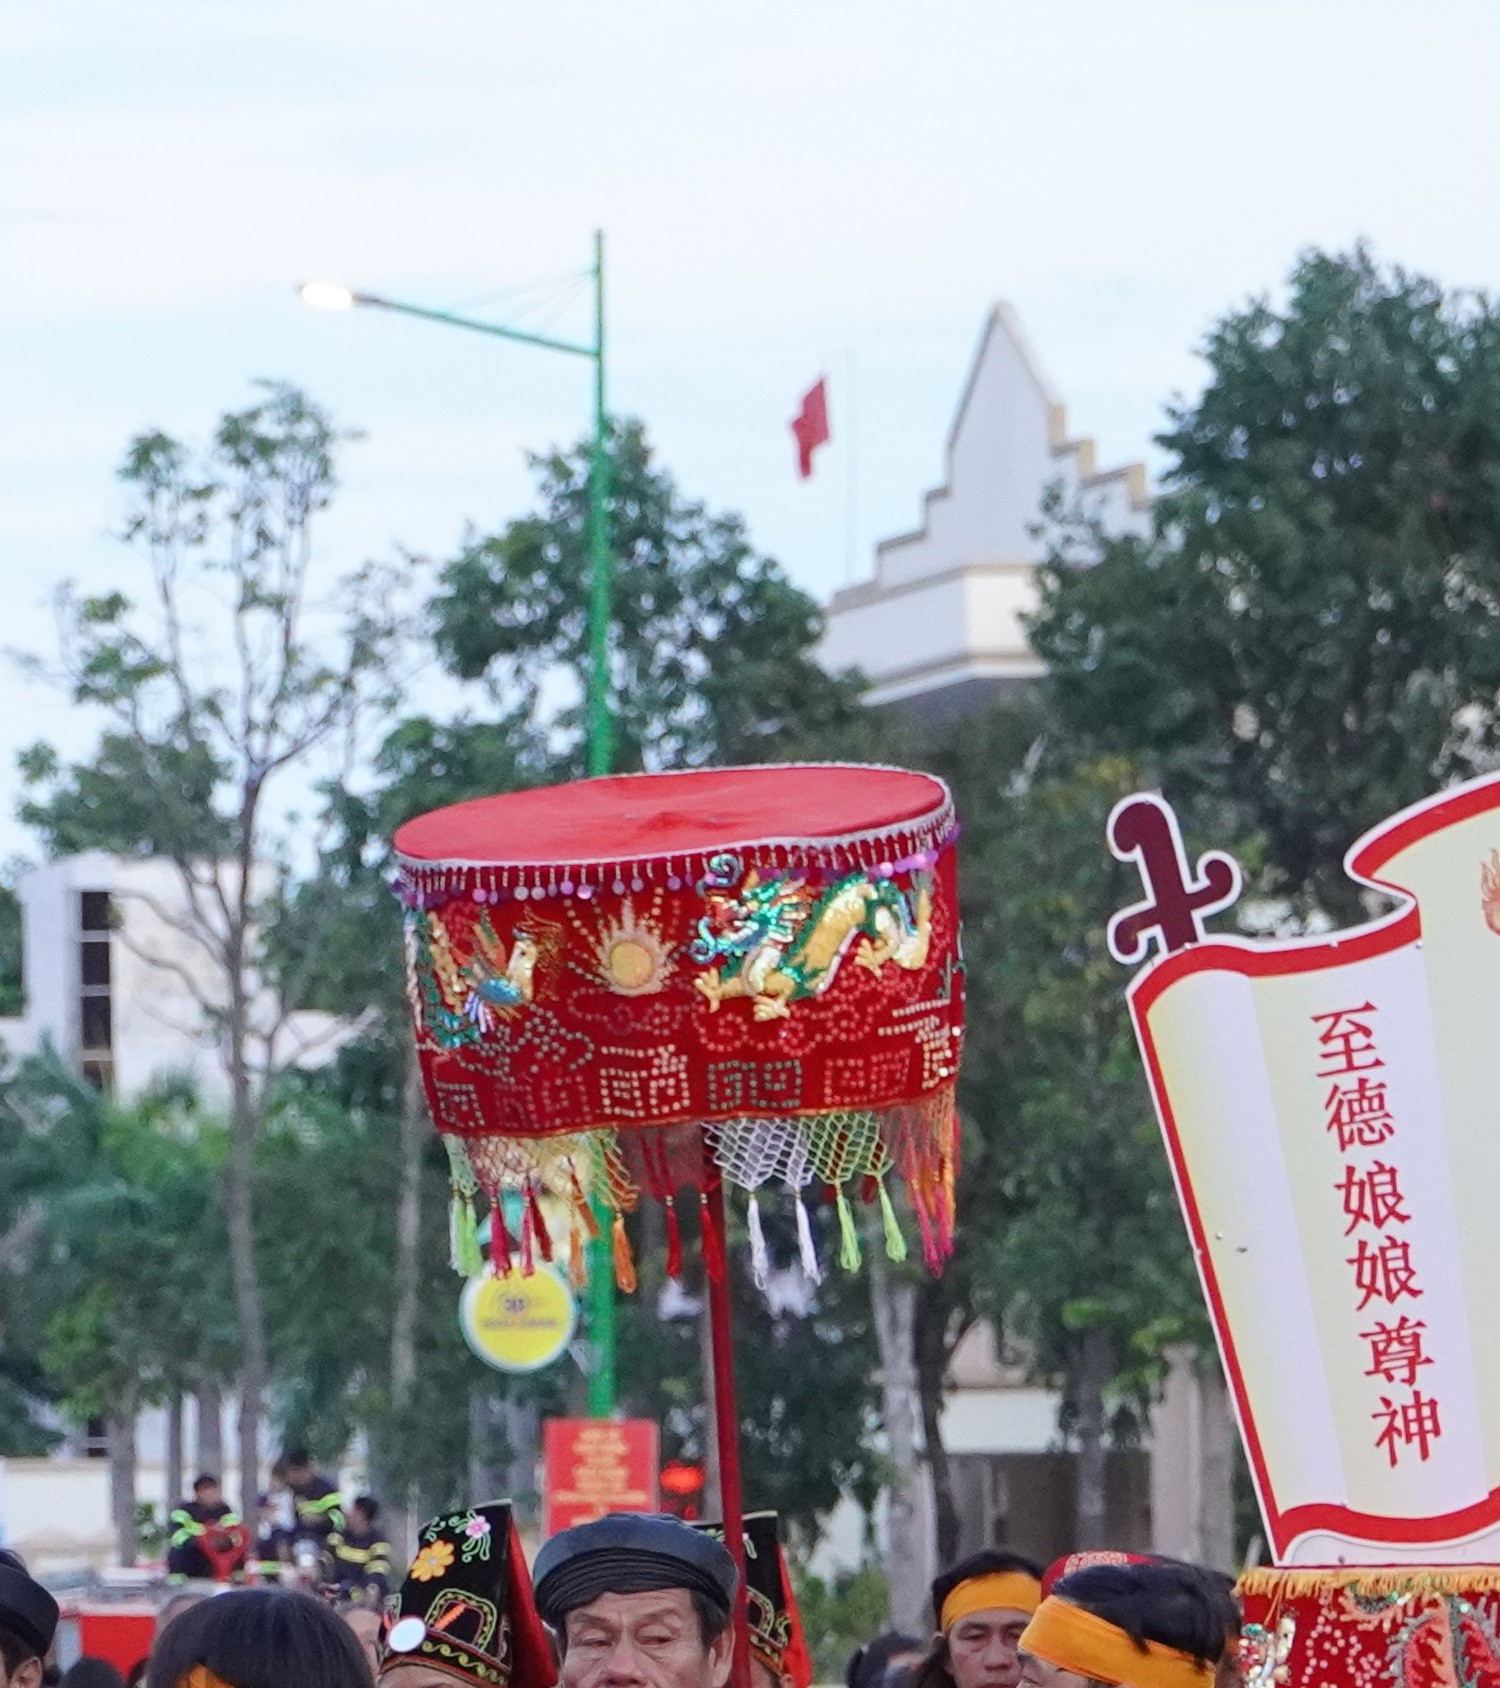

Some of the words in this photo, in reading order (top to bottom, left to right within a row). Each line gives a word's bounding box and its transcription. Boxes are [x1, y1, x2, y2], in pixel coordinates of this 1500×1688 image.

[1311, 1001, 1442, 1468] 至德娘娘尊神
